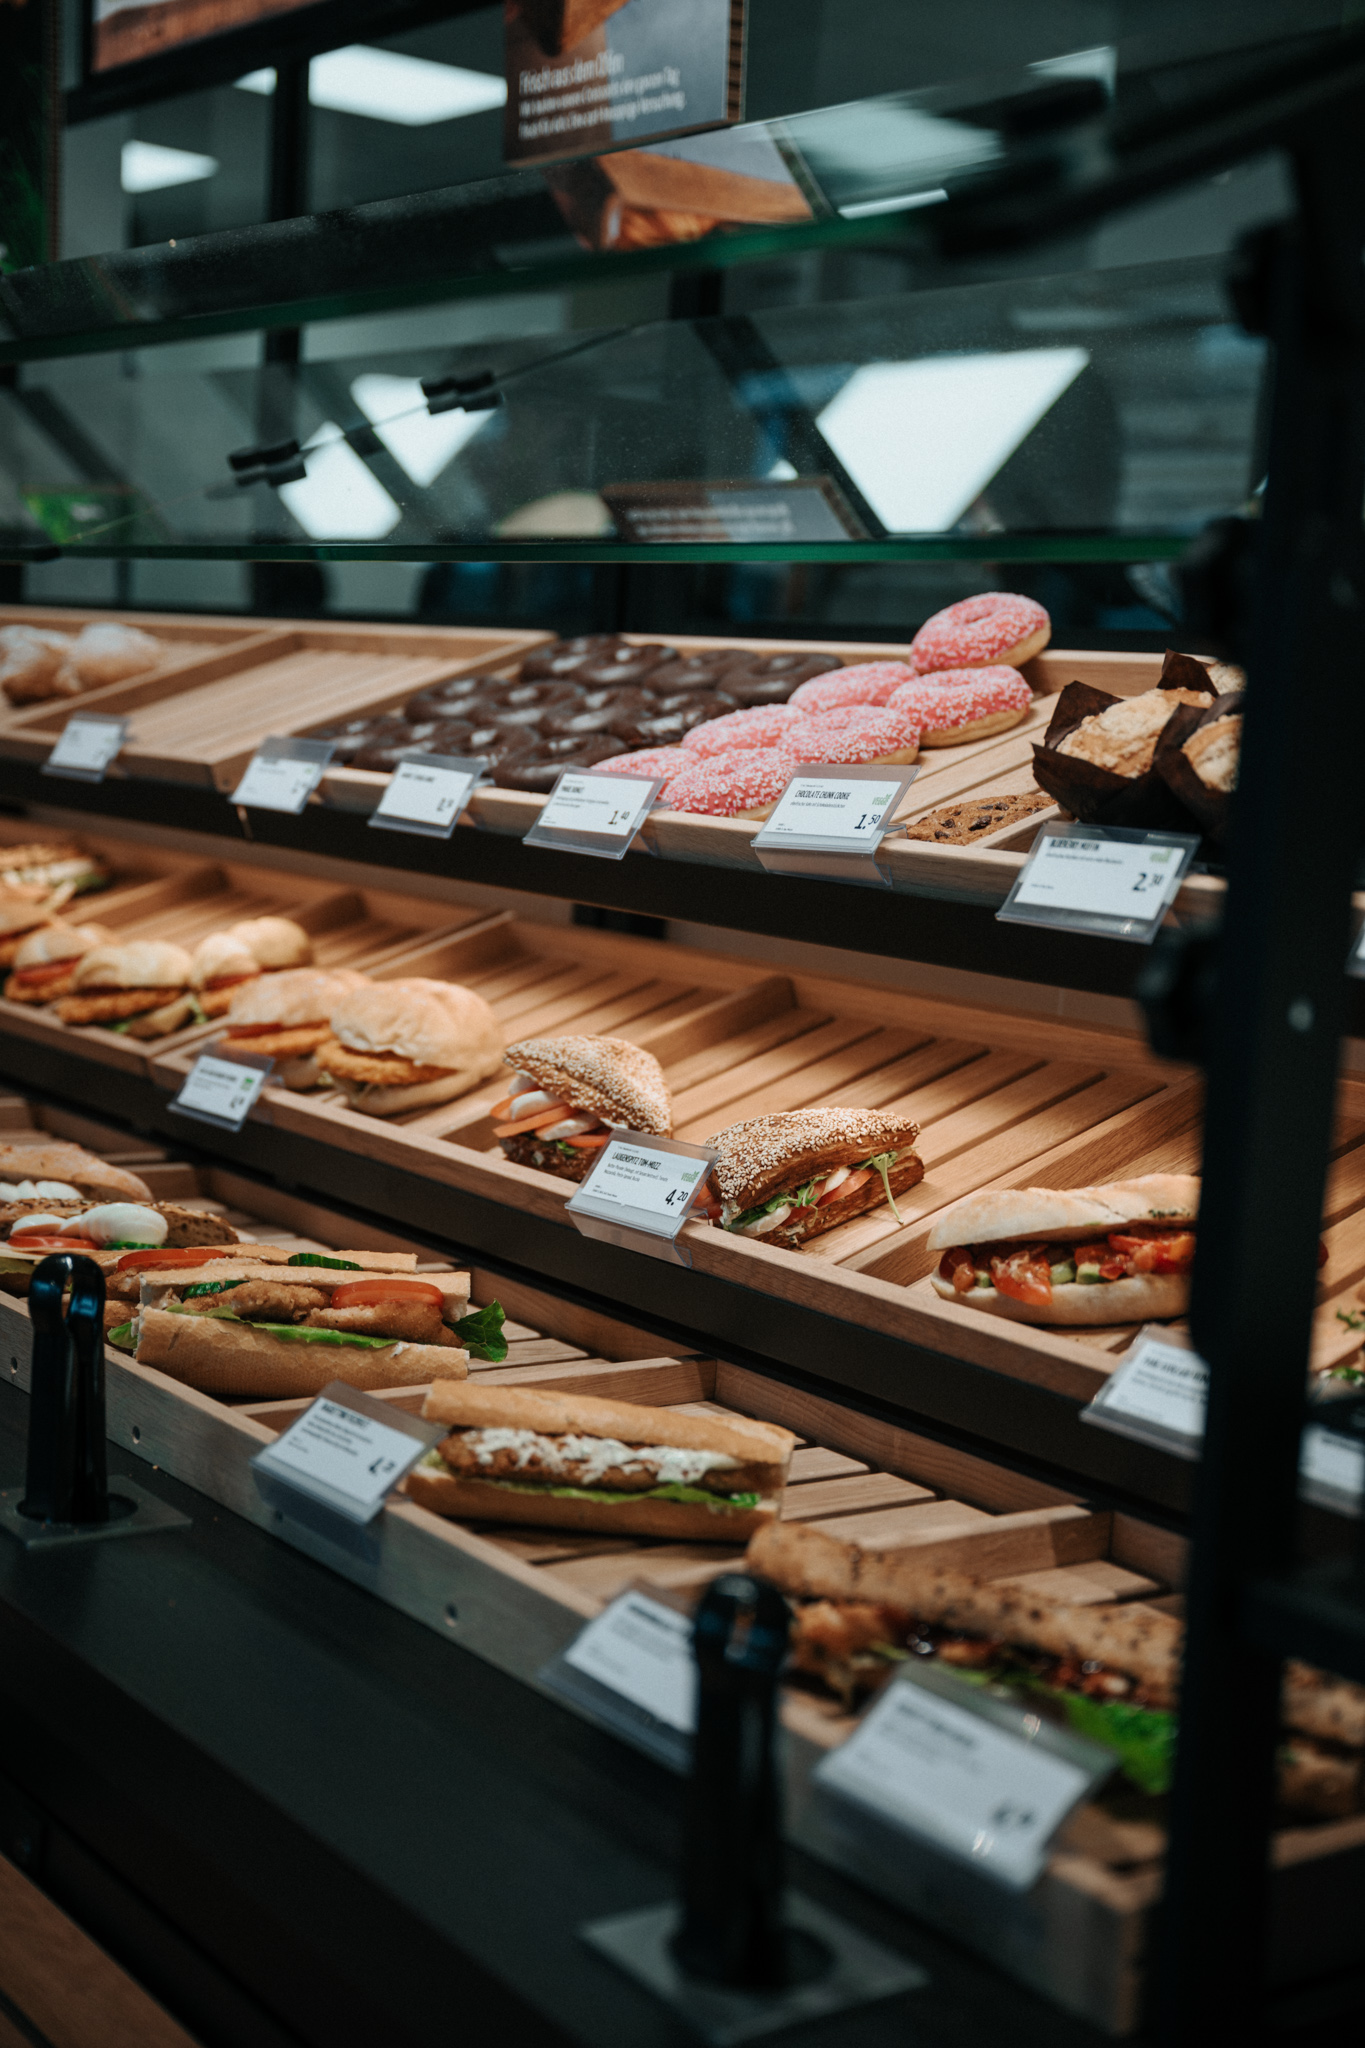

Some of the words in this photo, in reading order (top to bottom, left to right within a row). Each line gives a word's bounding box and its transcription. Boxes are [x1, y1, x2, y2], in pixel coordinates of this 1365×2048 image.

[795, 790, 821, 799] CHOCOLATE
[819, 791, 835, 799] CHUNK
[834, 792, 851, 800] COOKIE
[612, 1152, 639, 1165] LAUGENSPITZ
